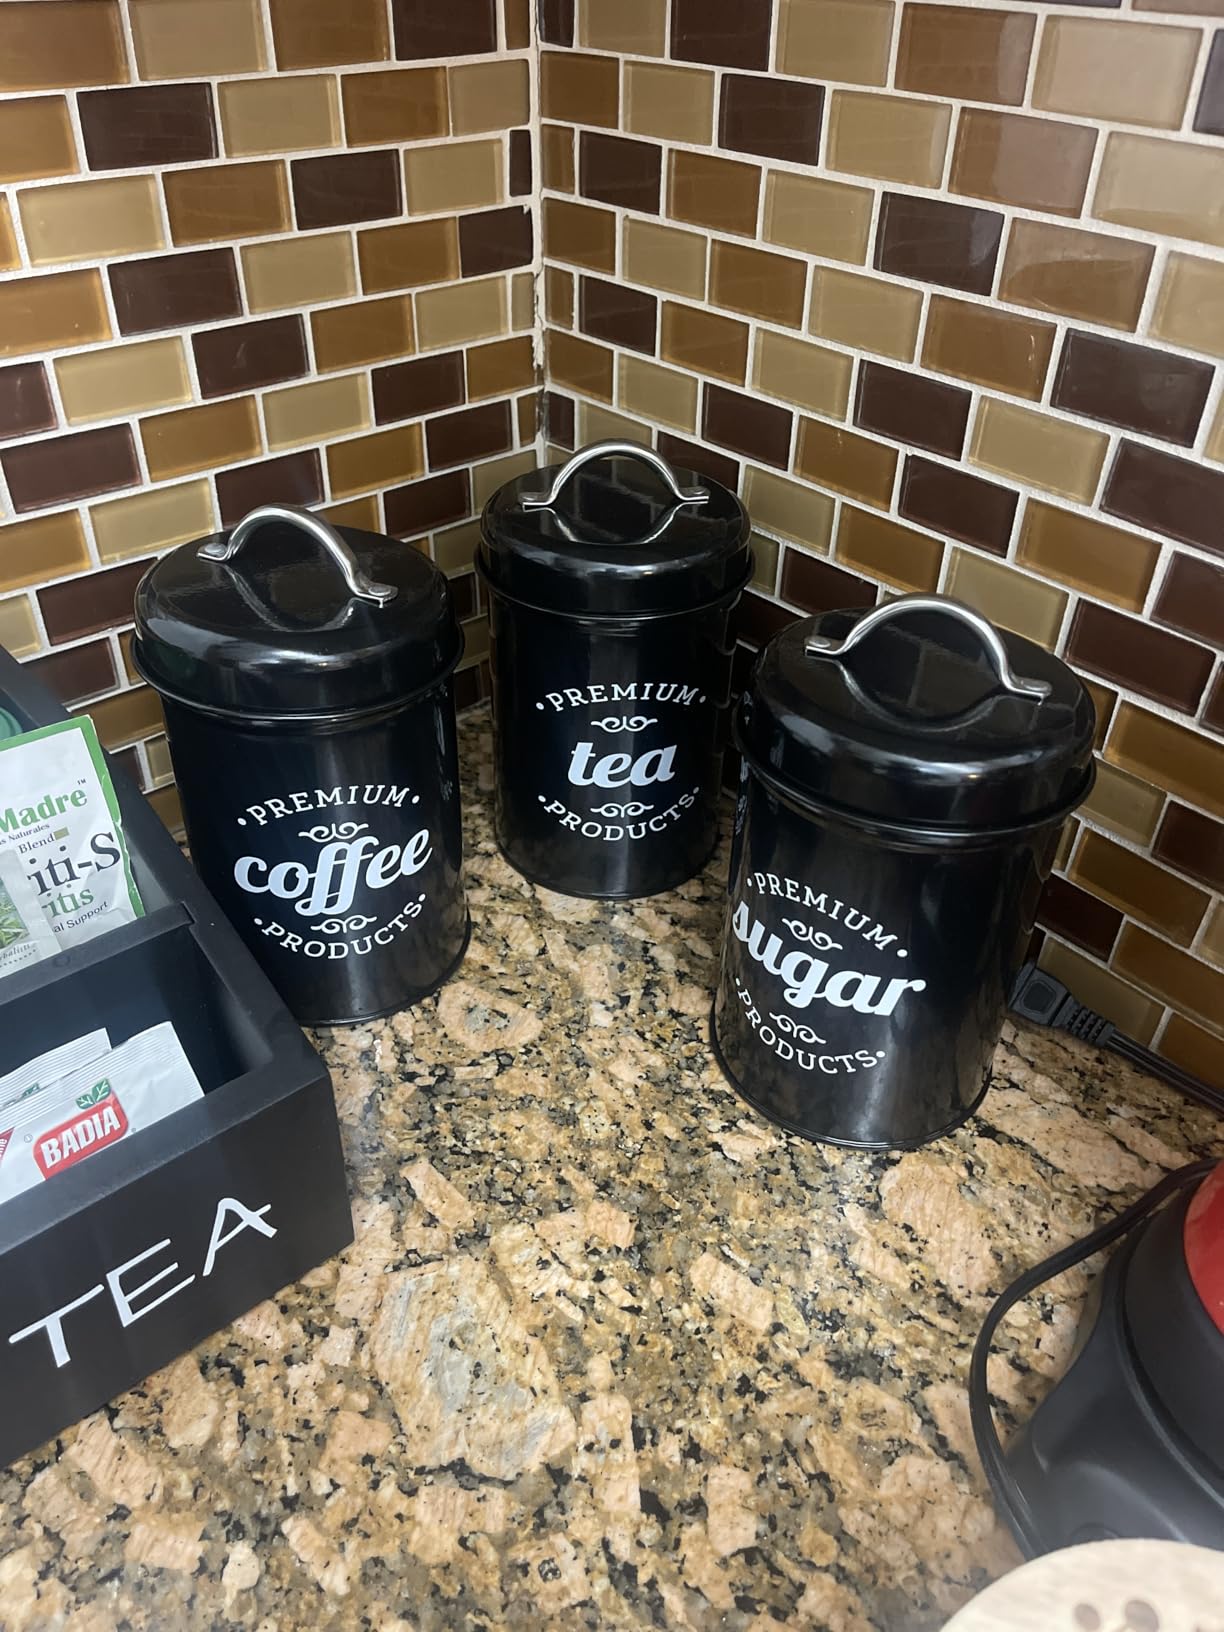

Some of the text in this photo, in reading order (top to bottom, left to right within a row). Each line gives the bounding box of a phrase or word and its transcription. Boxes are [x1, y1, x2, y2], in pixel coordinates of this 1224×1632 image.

[546, 683, 699, 712] PREMIUM
[567, 742, 677, 788] tea
[0, 789, 87, 832] Madre
[246, 784, 410, 826] PREMIUM
[543, 794, 695, 841] PRODUCTS
[8, 823, 50, 841] Naturales
[17, 833, 55, 854] Blend
[27, 832, 120, 896] iti-S
[234, 829, 433, 916] coffee
[41, 883, 94, 918] itis
[67, 901, 108, 929] Support
[754, 872, 898, 950] PREMIUM
[261, 901, 422, 959] PRODUCTS
[732, 900, 926, 1017] sugar
[737, 988, 878, 1074] PRODUCTS
[40, 1106, 121, 1169] BADIA
[8, 1197, 278, 1368] TEA
